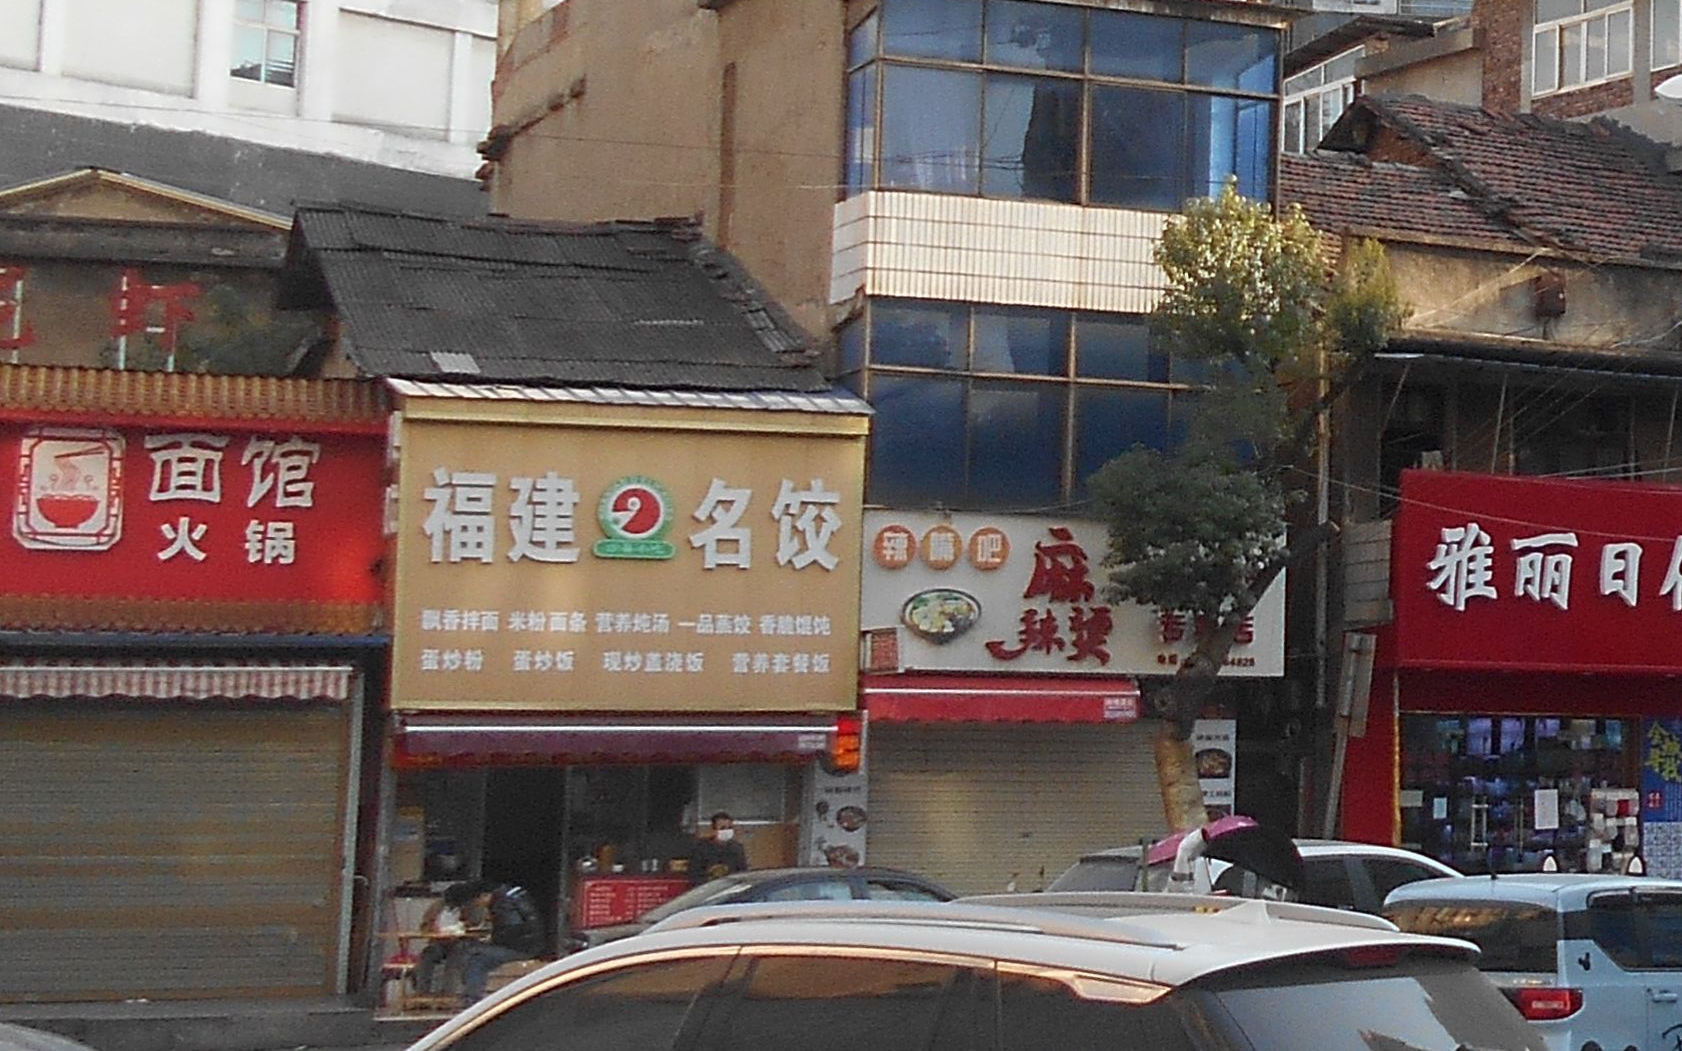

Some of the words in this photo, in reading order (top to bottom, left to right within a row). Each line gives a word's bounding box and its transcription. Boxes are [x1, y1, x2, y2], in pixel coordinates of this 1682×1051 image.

[145, 434, 320, 508] 面馆
[158, 517, 296, 564] 火锅
[424, 468, 580, 564] 福建
[691, 478, 842, 571] 名饺
[1024, 526, 1095, 602] 麻
[513, 651, 574, 671] 蛋炒饭
